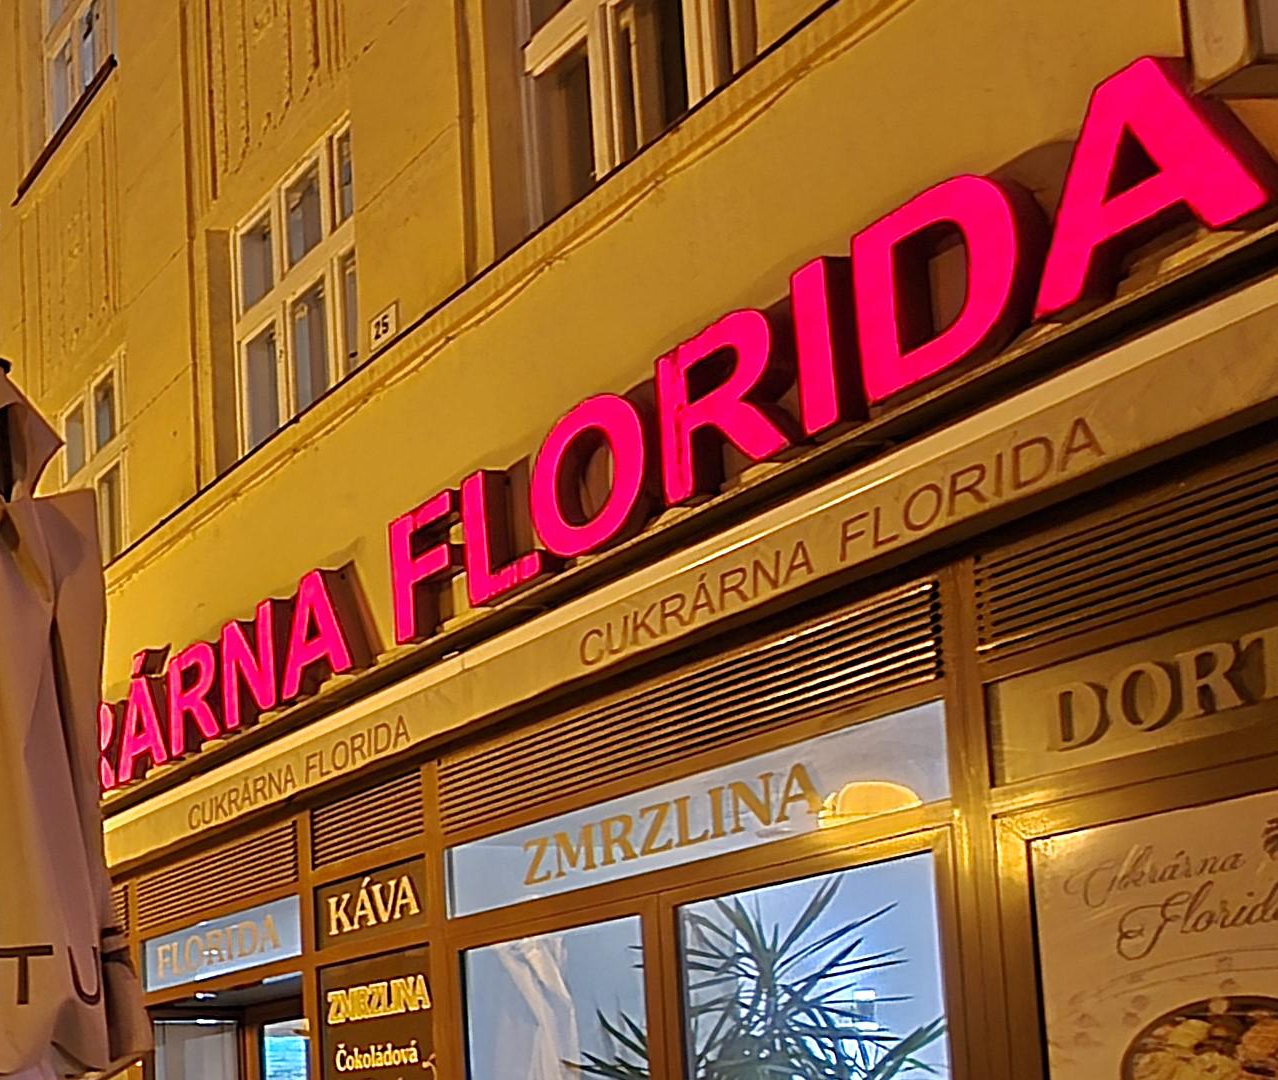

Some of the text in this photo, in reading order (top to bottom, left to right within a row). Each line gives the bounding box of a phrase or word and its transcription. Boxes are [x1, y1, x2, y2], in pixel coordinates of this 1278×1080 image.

[374, 313, 390, 340] 25
[387, 55, 1270, 646] FLORIDA
[579, 415, 1107, 667] CUKRÁRNA FLORIDA
[187, 714, 411, 831] CUKRÁRNA FLORIDA
[522, 762, 824, 886] ZMRZLINA
[327, 876, 420, 936] KÁVA
[1116, 880, 1278, 961] Florid
[156, 914, 282, 980] FLORIDA
[327, 974, 432, 1025] ZMRZLINA
[335, 1039, 419, 1072] Čokoládová
